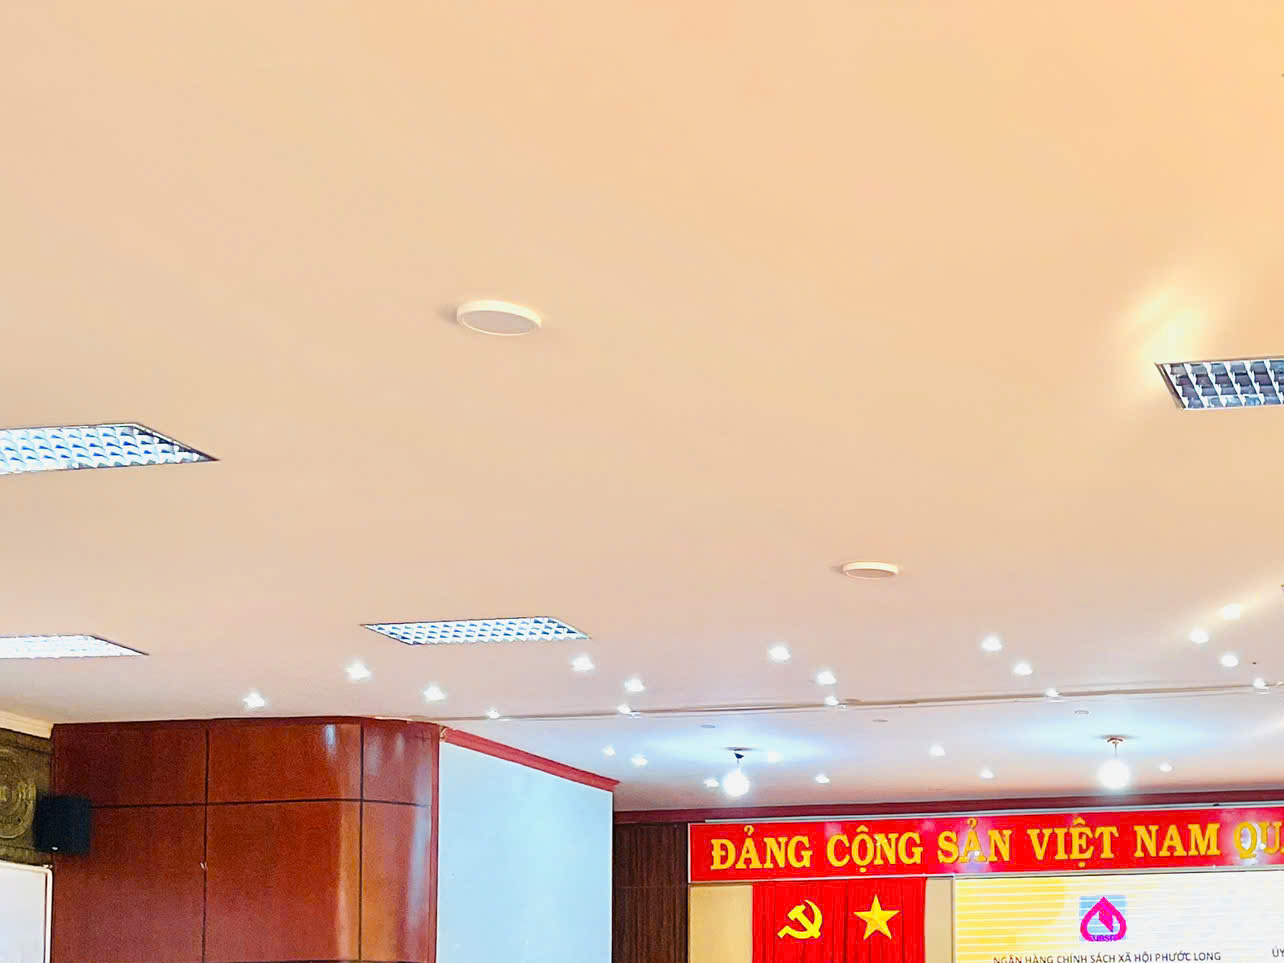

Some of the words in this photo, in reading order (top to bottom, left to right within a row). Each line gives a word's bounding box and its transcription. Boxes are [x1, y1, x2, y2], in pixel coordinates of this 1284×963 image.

[710, 825, 813, 870] ĐẢNG
[826, 826, 923, 873] CỘNG
[937, 817, 1011, 864] SẢN
[1027, 816, 1119, 869] VIỆT
[1134, 823, 1221, 858] NAM
[1056, 951, 1088, 963] CHÍNH
[1090, 951, 1116, 963] SÁCH
[1118, 951, 1132, 963] XÃ
[1134, 950, 1153, 963] HỘI
[1155, 950, 1191, 962] PHƯỚC
[1193, 951, 1222, 962] LONG
